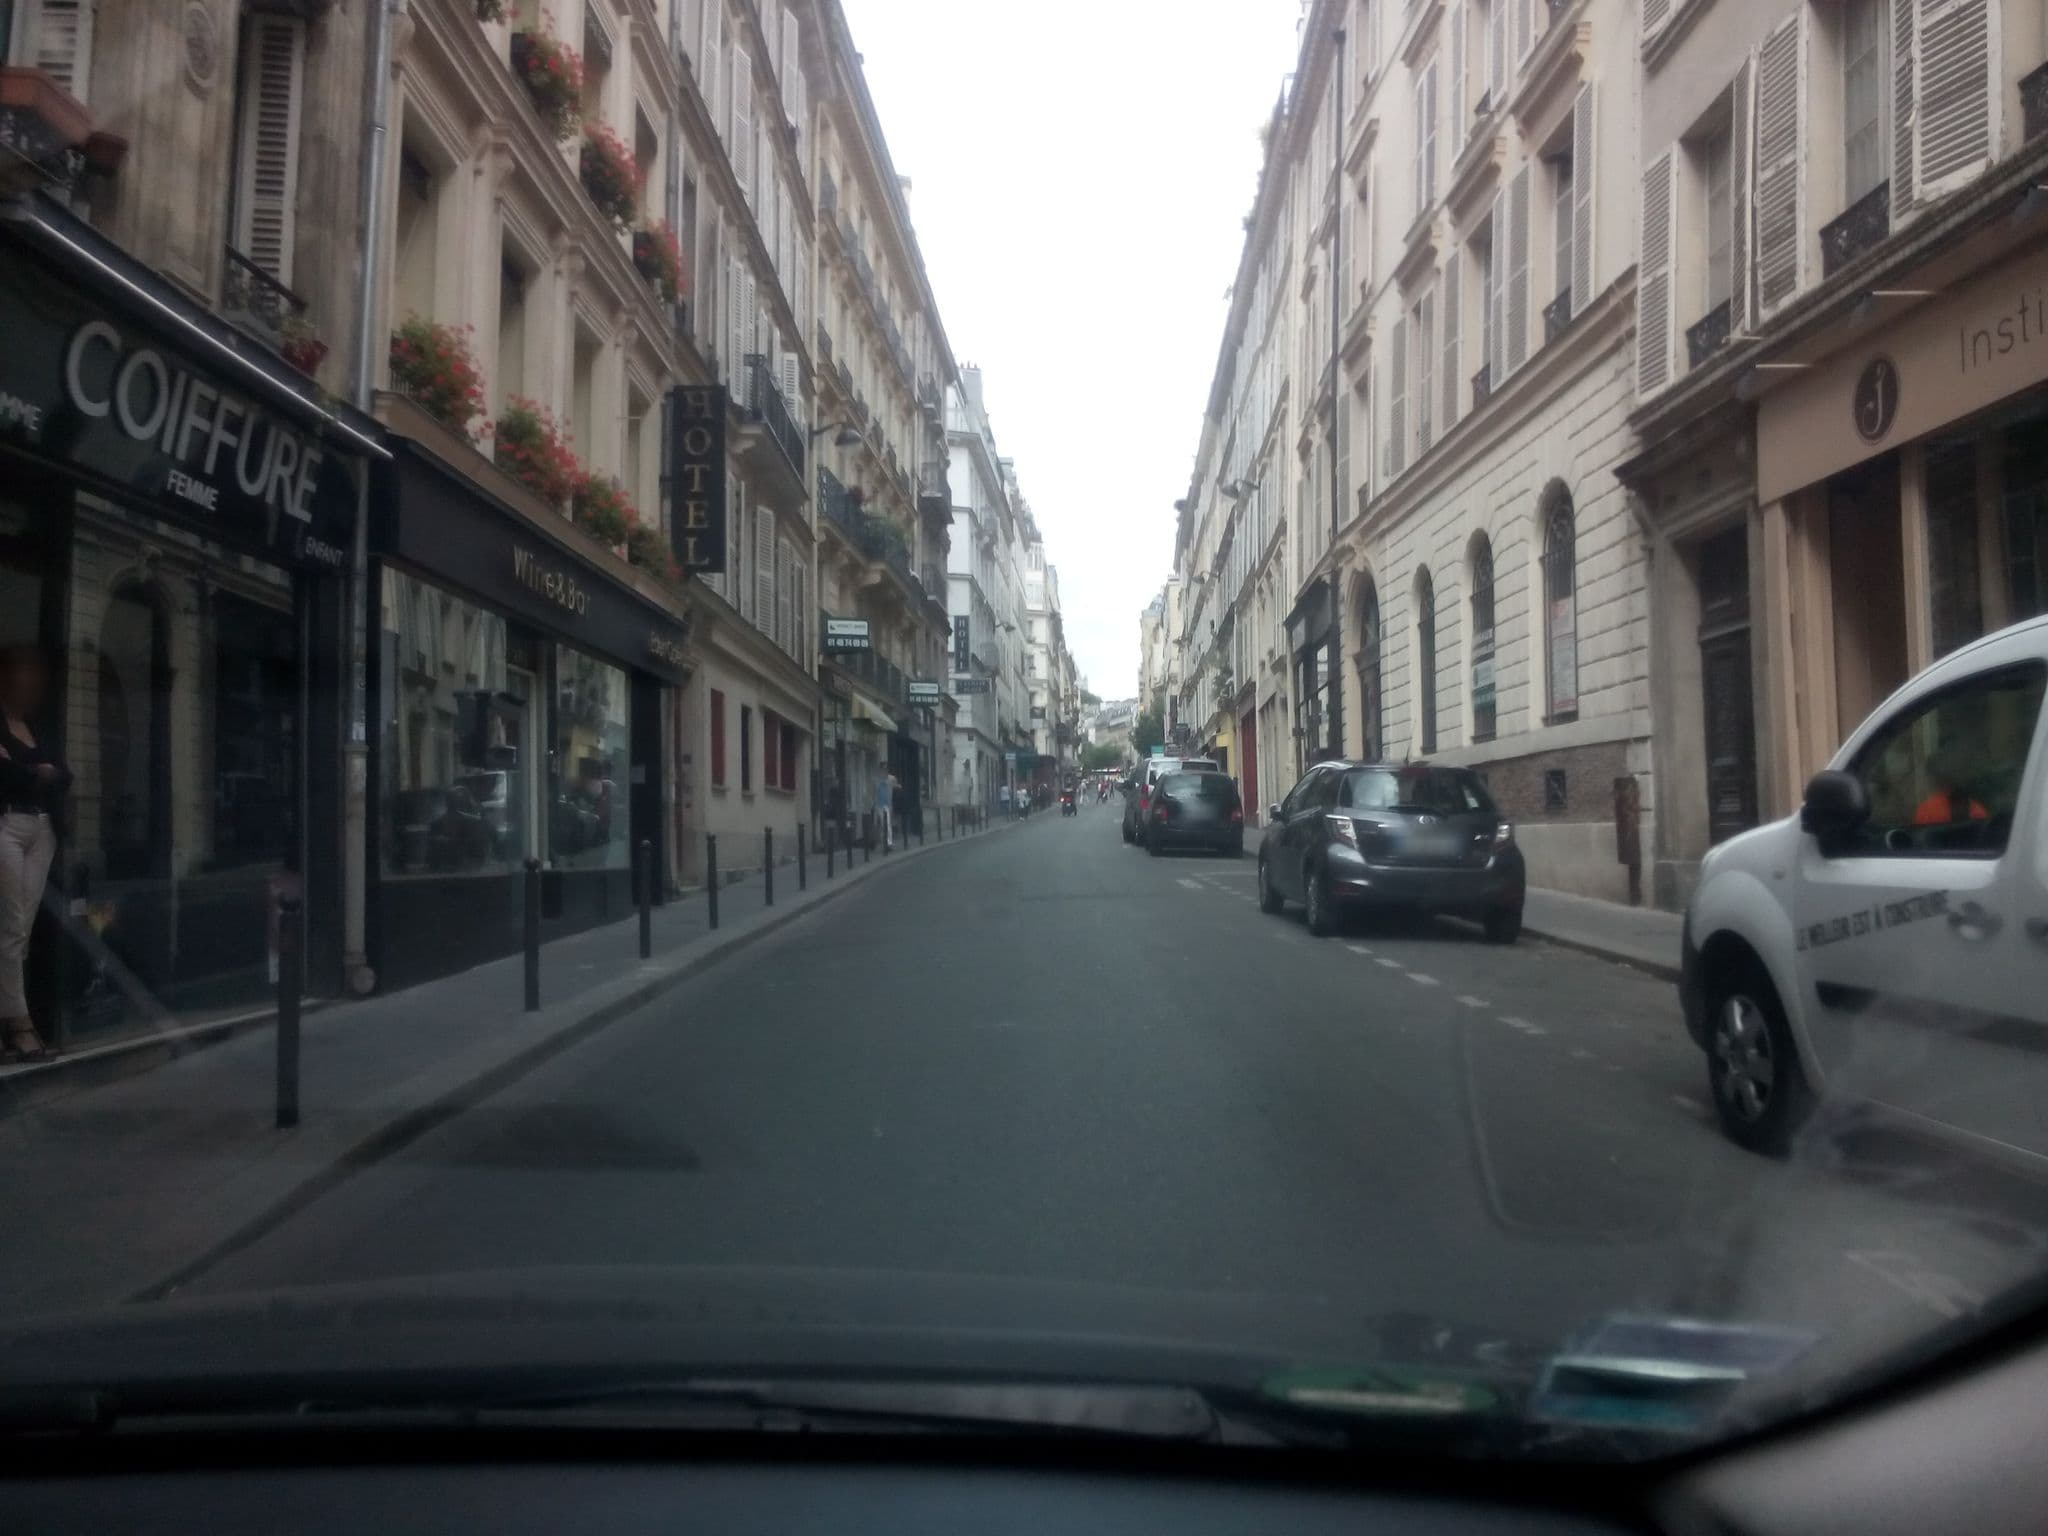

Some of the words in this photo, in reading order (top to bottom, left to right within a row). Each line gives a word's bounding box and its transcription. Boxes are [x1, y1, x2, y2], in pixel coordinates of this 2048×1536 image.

[66, 319, 323, 524] COIFFURE
[166, 468, 219, 512] FEMME
[684, 390, 711, 566] HOTEL
